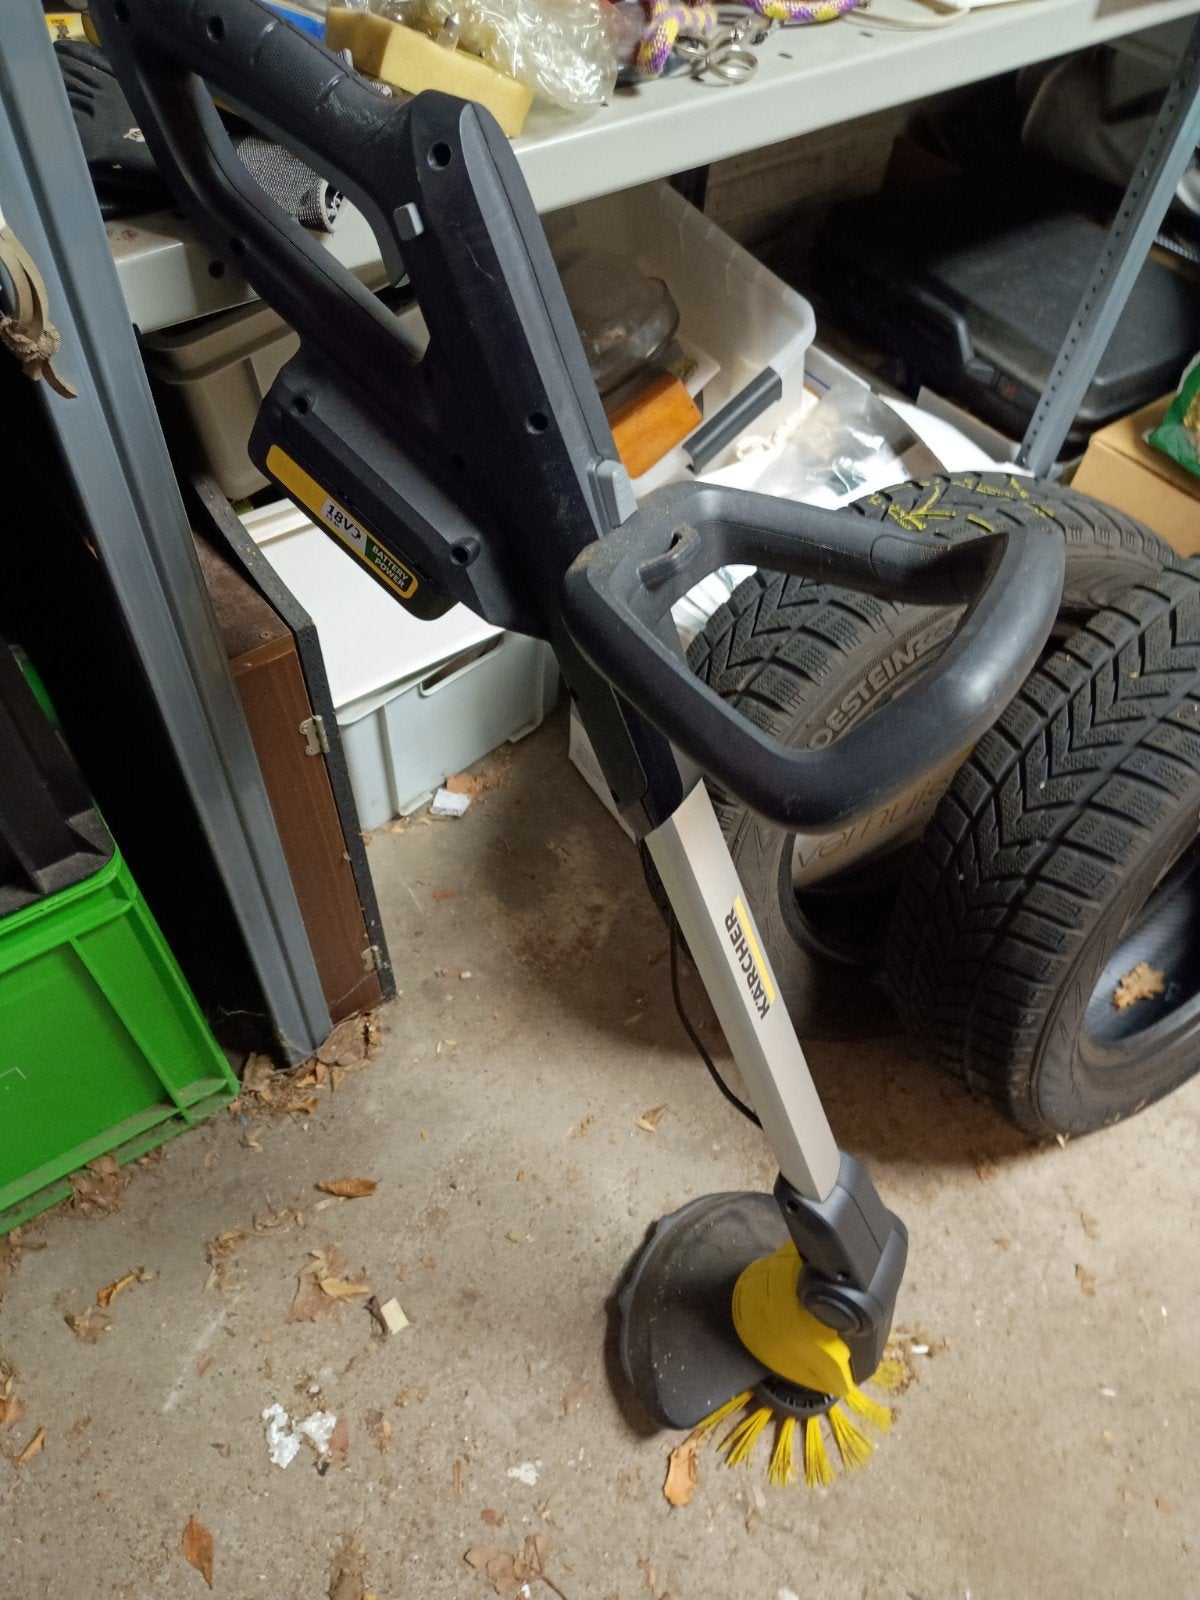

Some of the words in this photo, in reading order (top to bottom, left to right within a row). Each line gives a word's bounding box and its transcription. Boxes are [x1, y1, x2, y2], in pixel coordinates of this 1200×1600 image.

[326, 505, 354, 531] 18V
[372, 545, 408, 580] BATTERY
[375, 558, 406, 588] POWER
[724, 907, 770, 1021] KÄRCHER
